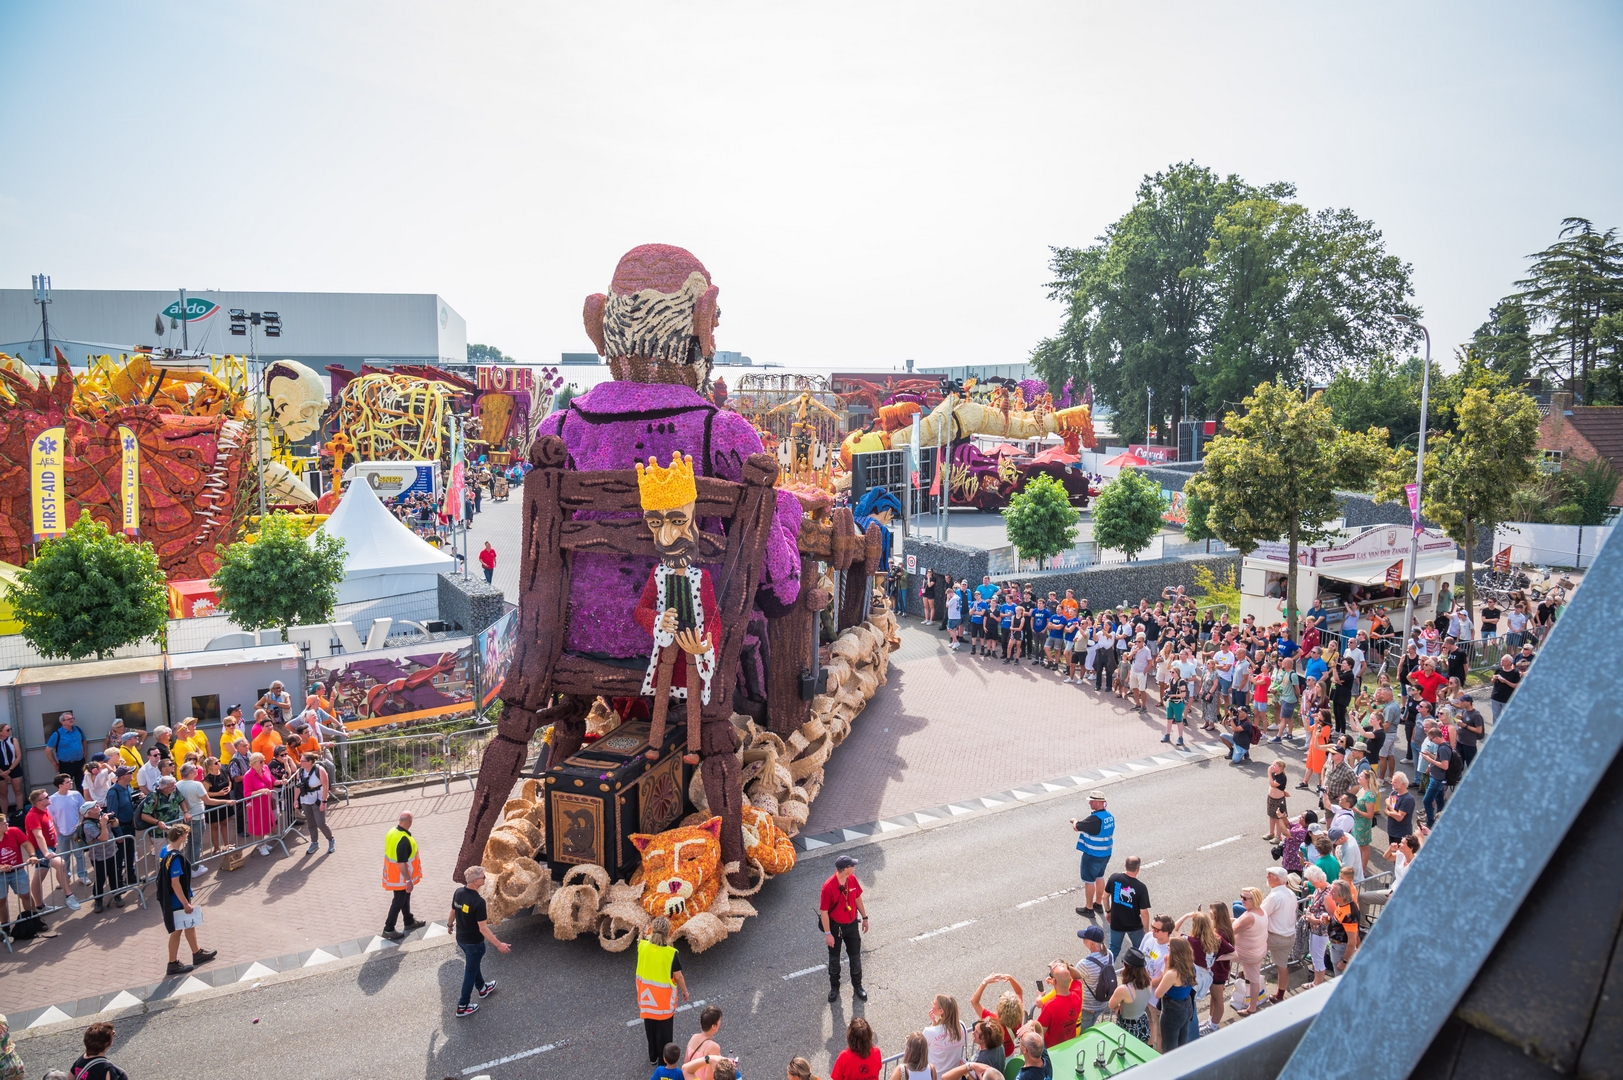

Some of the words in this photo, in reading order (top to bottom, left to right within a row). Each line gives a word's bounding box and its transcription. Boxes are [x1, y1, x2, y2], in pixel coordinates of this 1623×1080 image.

[169, 302, 207, 314] ado
[378, 475, 403, 485] SNEP
[41, 471, 56, 529] FIRST-AID
